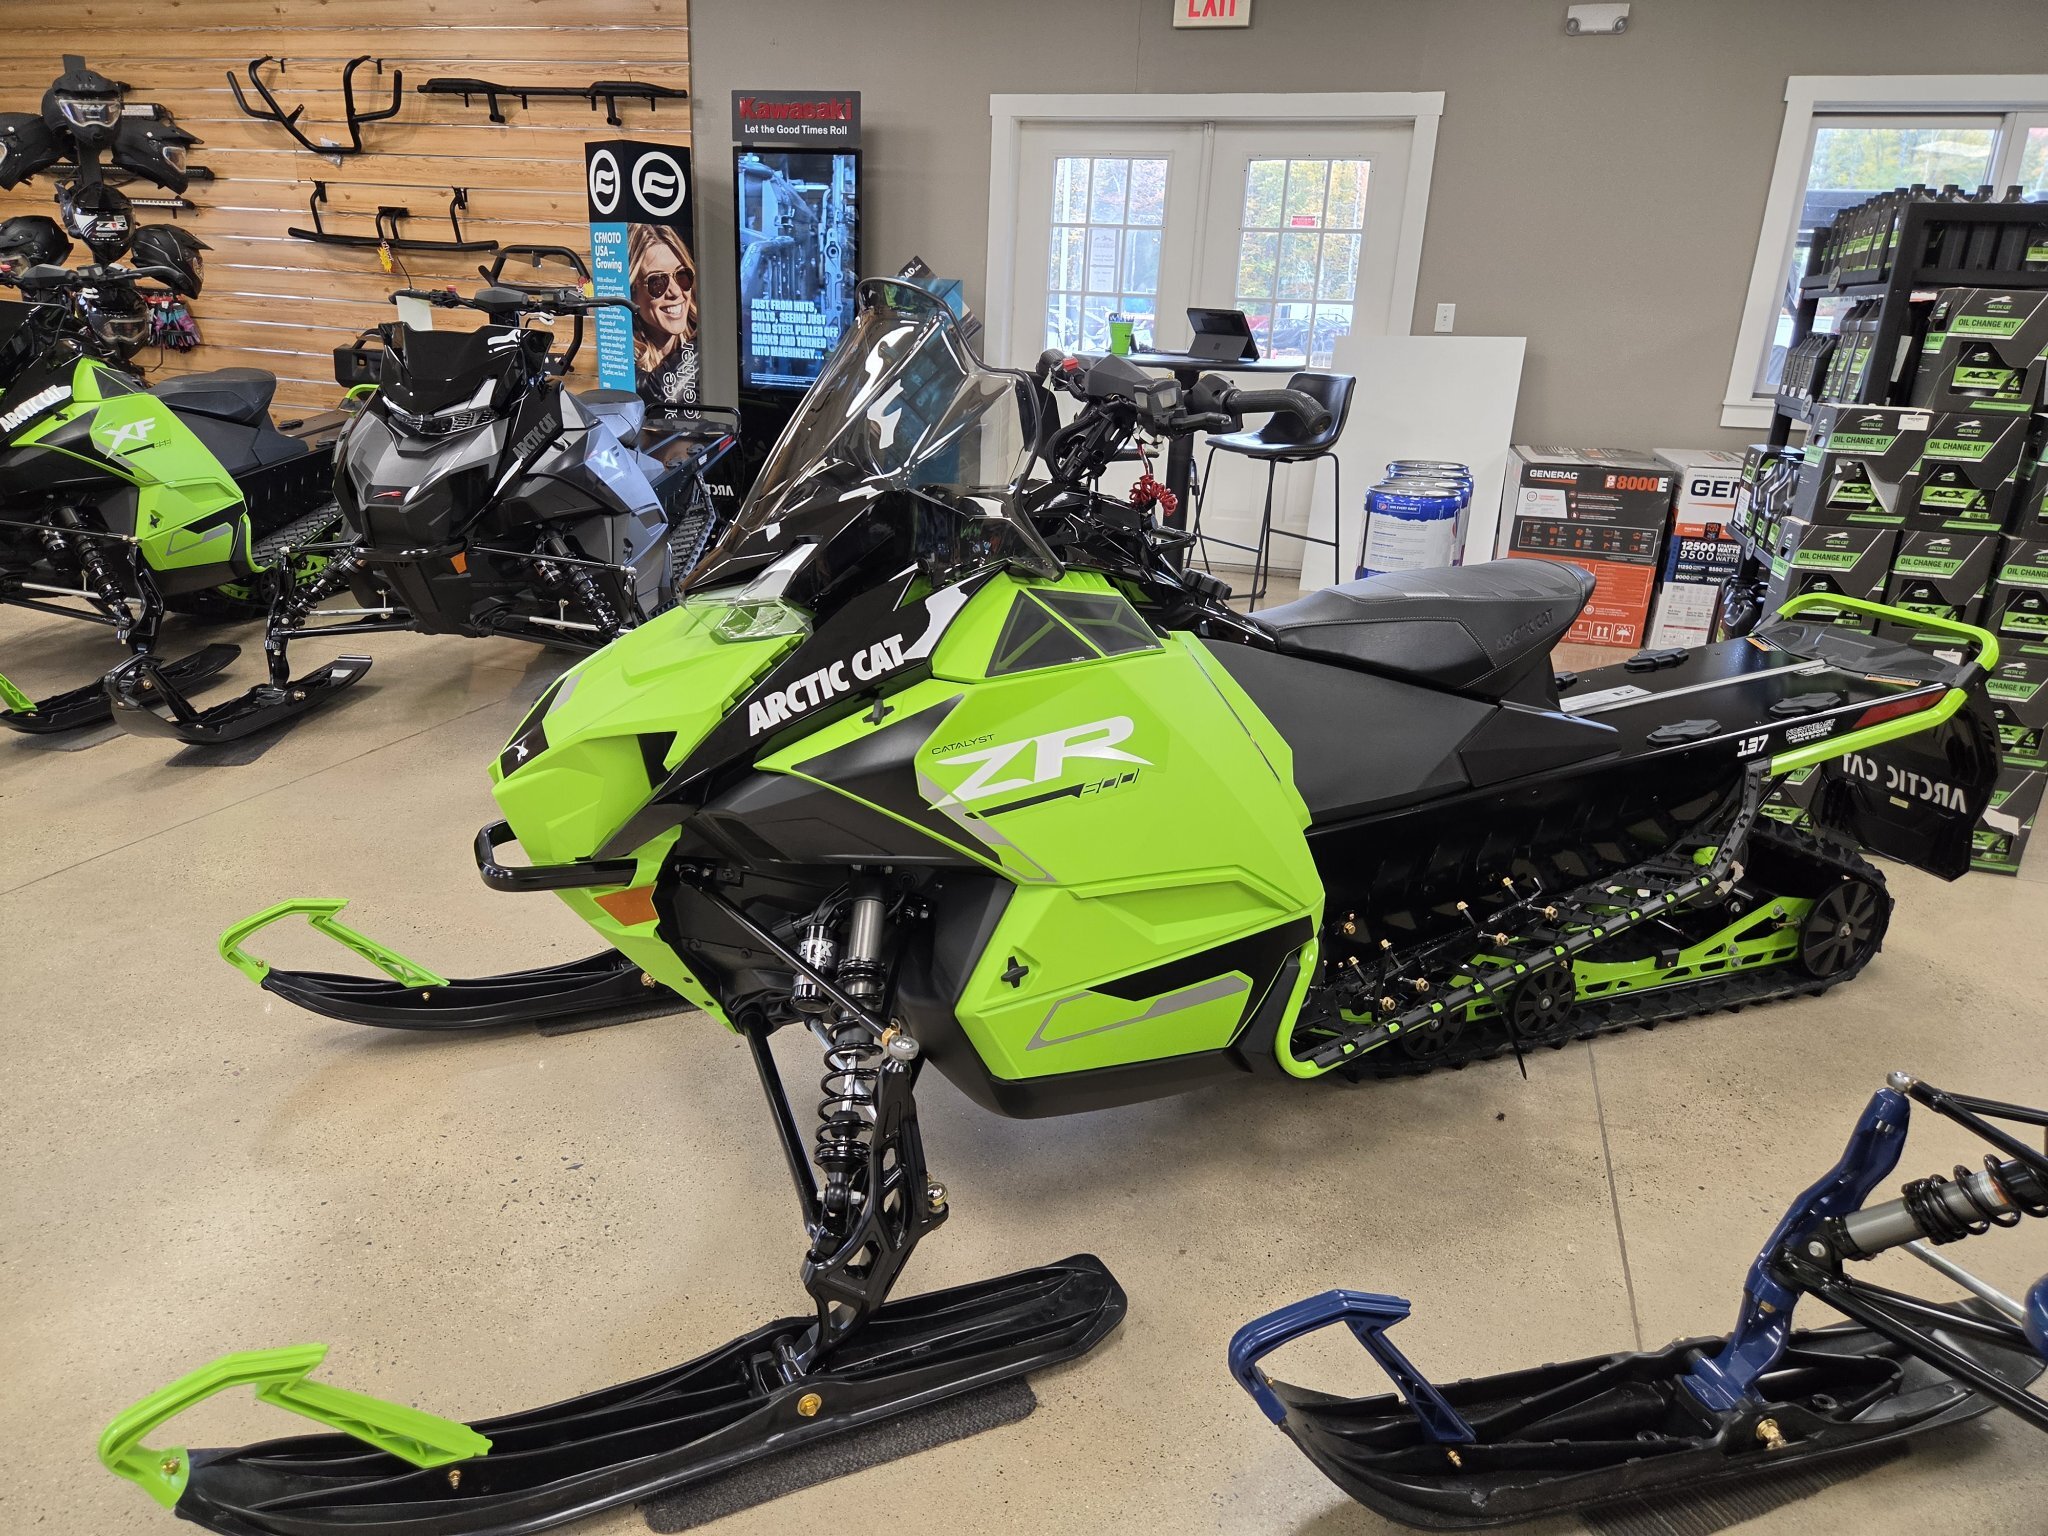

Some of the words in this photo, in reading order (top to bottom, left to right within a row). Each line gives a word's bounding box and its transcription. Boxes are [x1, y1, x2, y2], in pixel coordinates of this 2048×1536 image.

[739, 97, 853, 121] Kawasaki
[745, 124, 758, 134] Let
[761, 124, 775, 134] the
[776, 125, 800, 134] Good
[801, 125, 828, 135] Times
[830, 126, 848, 135] Roll
[594, 231, 622, 244] CFMOTO
[596, 257, 623, 273] Growing
[751, 298, 770, 309] JUST
[771, 299, 793, 311] FROM
[793, 300, 818, 314] NUTS,
[751, 310, 778, 324] BOLTS,
[779, 311, 807, 324] SEEING
[807, 313, 826, 325] JUST
[1971, 319, 2001, 328] CHANGE
[751, 321, 771, 334] COLD
[772, 322, 795, 335] STEEL
[795, 324, 823, 337] PULLED
[824, 326, 839, 338] OFF
[751, 333, 779, 346] RACKS
[779, 335, 796, 347] AND
[796, 336, 827, 349] TURNED
[751, 344, 770, 356] INTO
[101, 417, 155, 459] XF
[512, 425, 546, 459] ARCTIC
[538, 413, 558, 434] CAT
[1846, 436, 1874, 444] CHANGE
[1942, 443, 1972, 451] CHANGE
[1974, 444, 1986, 452] KIT
[1530, 470, 1578, 480] GENERAC
[1929, 490, 1968, 498] ACX
[1976, 495, 1985, 507] 4
[1681, 541, 1716, 552] 12500
[1680, 550, 1714, 560] 9500
[1716, 556, 1738, 564] WATTS
[1812, 553, 1840, 561] CHANGE
[1914, 559, 1942, 568] CHANGE
[1906, 606, 1940, 614] ACX
[749, 660, 850, 737] ARCTIC
[852, 633, 905, 681] CAT
[1988, 682, 2018, 690] CHANGE
[2020, 684, 2031, 692] KIT
[1786, 718, 1836, 737] NORTHEAST
[931, 733, 995, 755] CATALYST
[2026, 733, 2034, 744] 4
[1737, 734, 1769, 757] 137
[927, 716, 1154, 811] ZR
